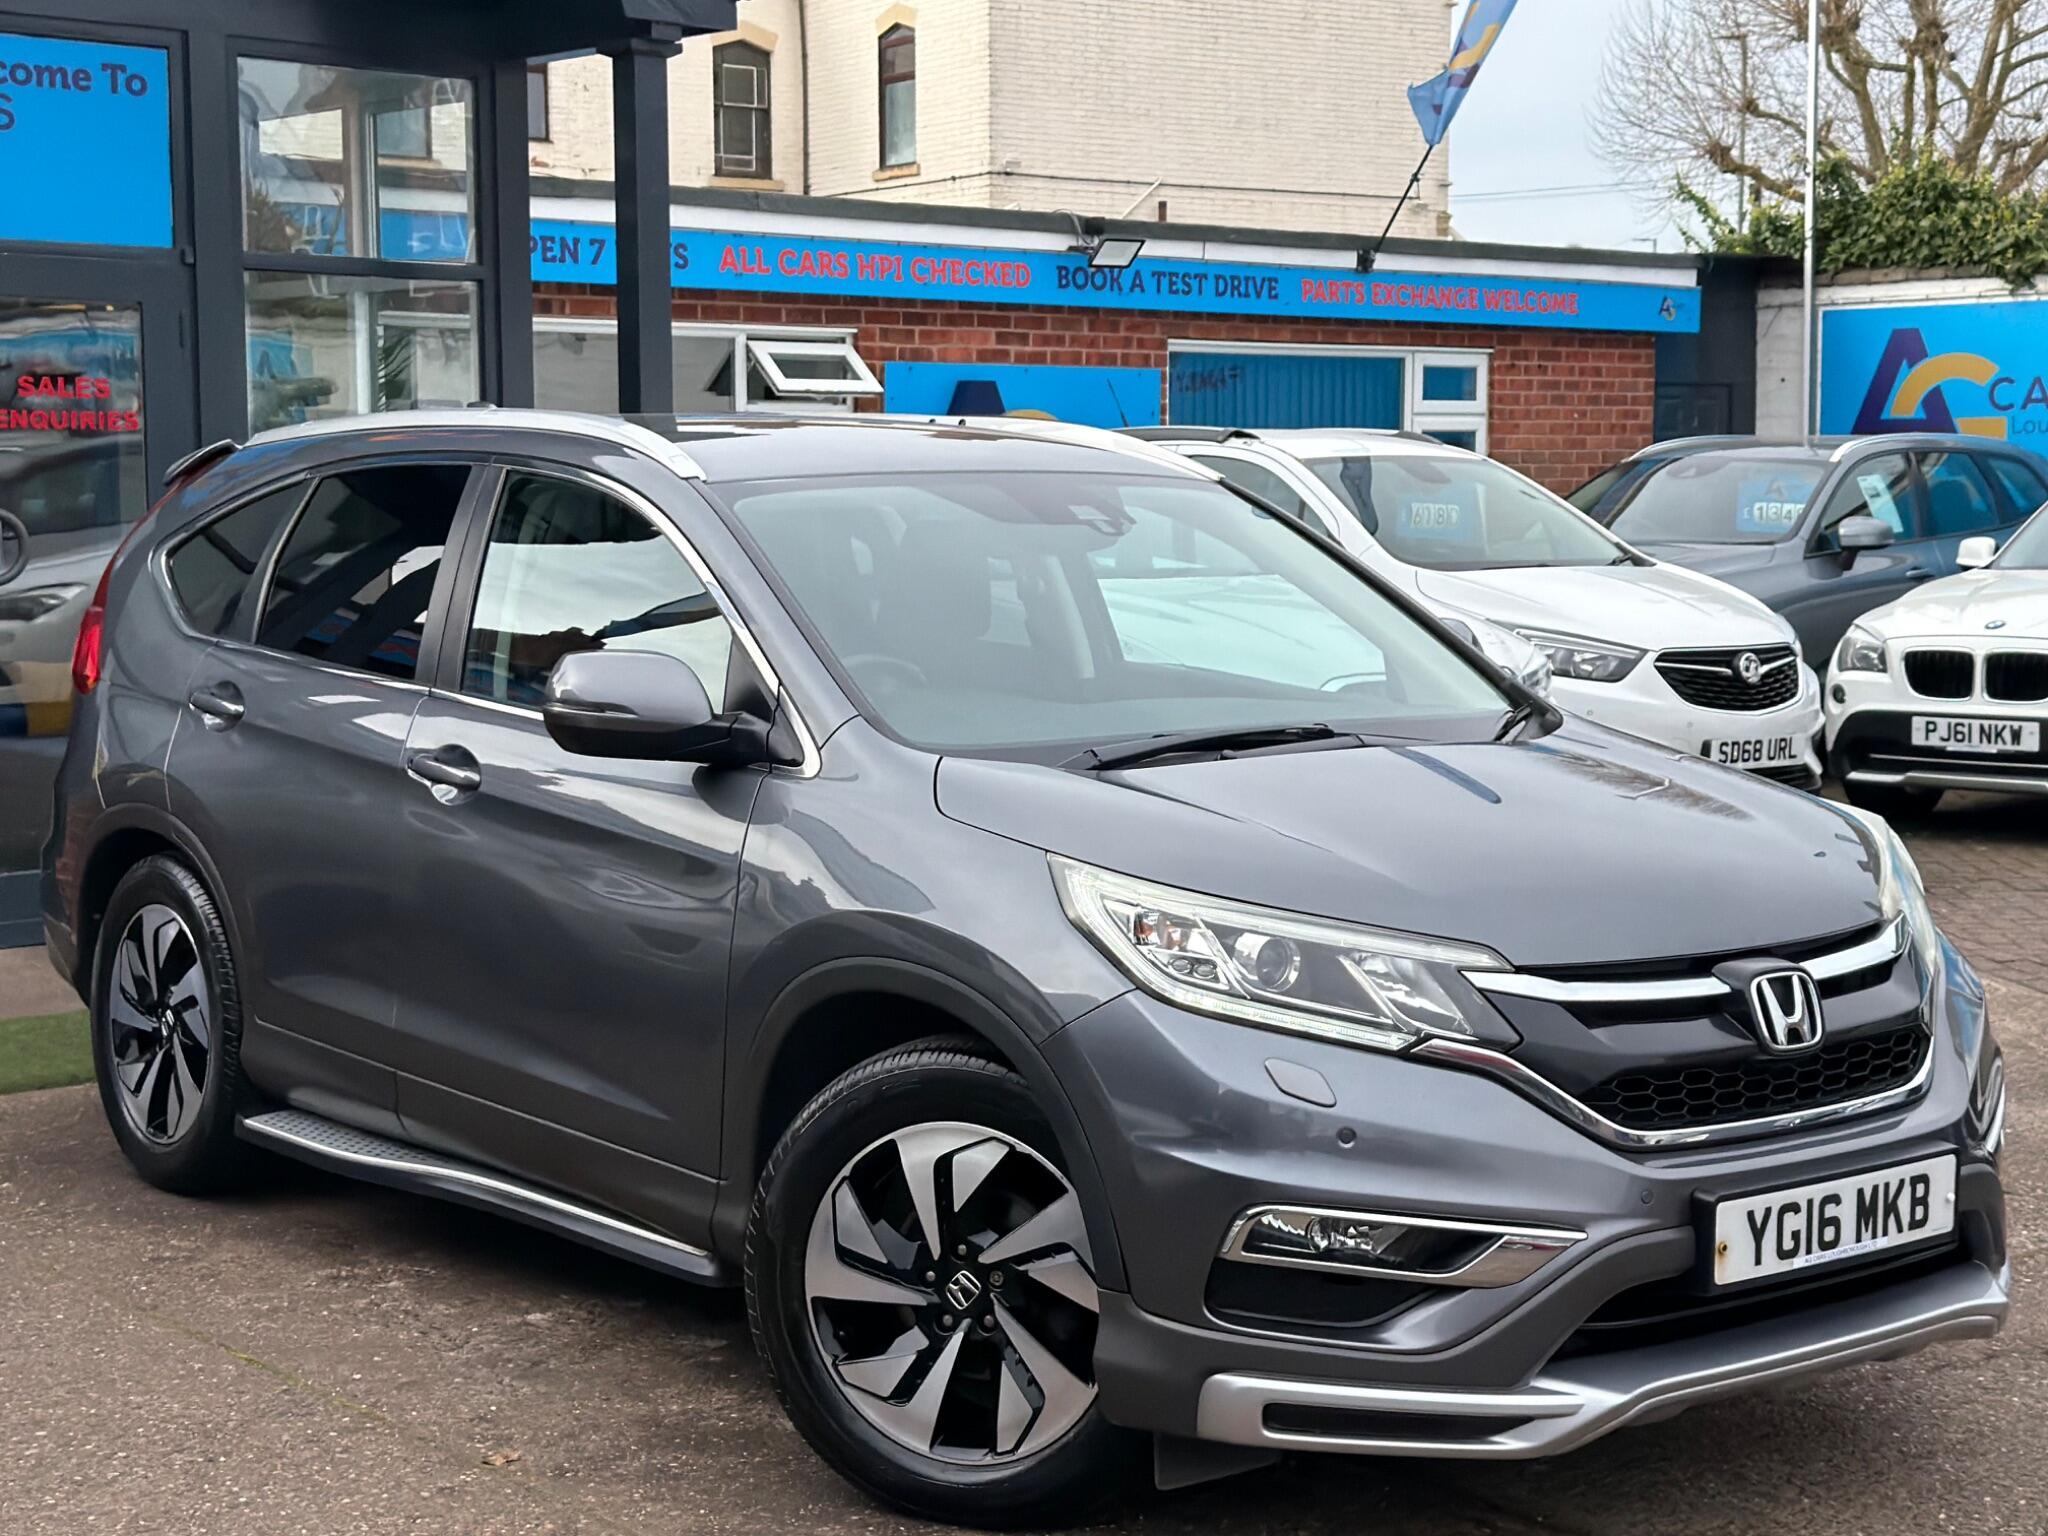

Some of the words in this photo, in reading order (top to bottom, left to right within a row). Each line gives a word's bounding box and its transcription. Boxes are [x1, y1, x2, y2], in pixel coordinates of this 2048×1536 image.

[101, 63, 148, 97] To
[589, 238, 606, 265] 7
[719, 246, 771, 274] ALL
[778, 249, 849, 279] CARS
[857, 253, 903, 282] HPI
[910, 256, 1032, 288] CHECKED
[1056, 265, 1124, 293] BOOK
[1129, 270, 1146, 294] A
[1151, 271, 1208, 296] TEST
[1214, 274, 1279, 299] DRIVE
[1301, 279, 1365, 304] PARTS
[1372, 282, 1478, 310] EXCHANGE
[1484, 288, 1578, 314] WELCOME
[18, 375, 111, 399] SALES
[0, 408, 139, 432] ENQUIRIES
[1924, 720, 1972, 743] PJ61
[1979, 723, 2023, 746] NKW
[1718, 740, 1763, 764] SD68
[1767, 737, 1798, 760] URL
[1746, 1193, 1842, 1266] YG16
[1855, 1173, 1931, 1243] MKB
